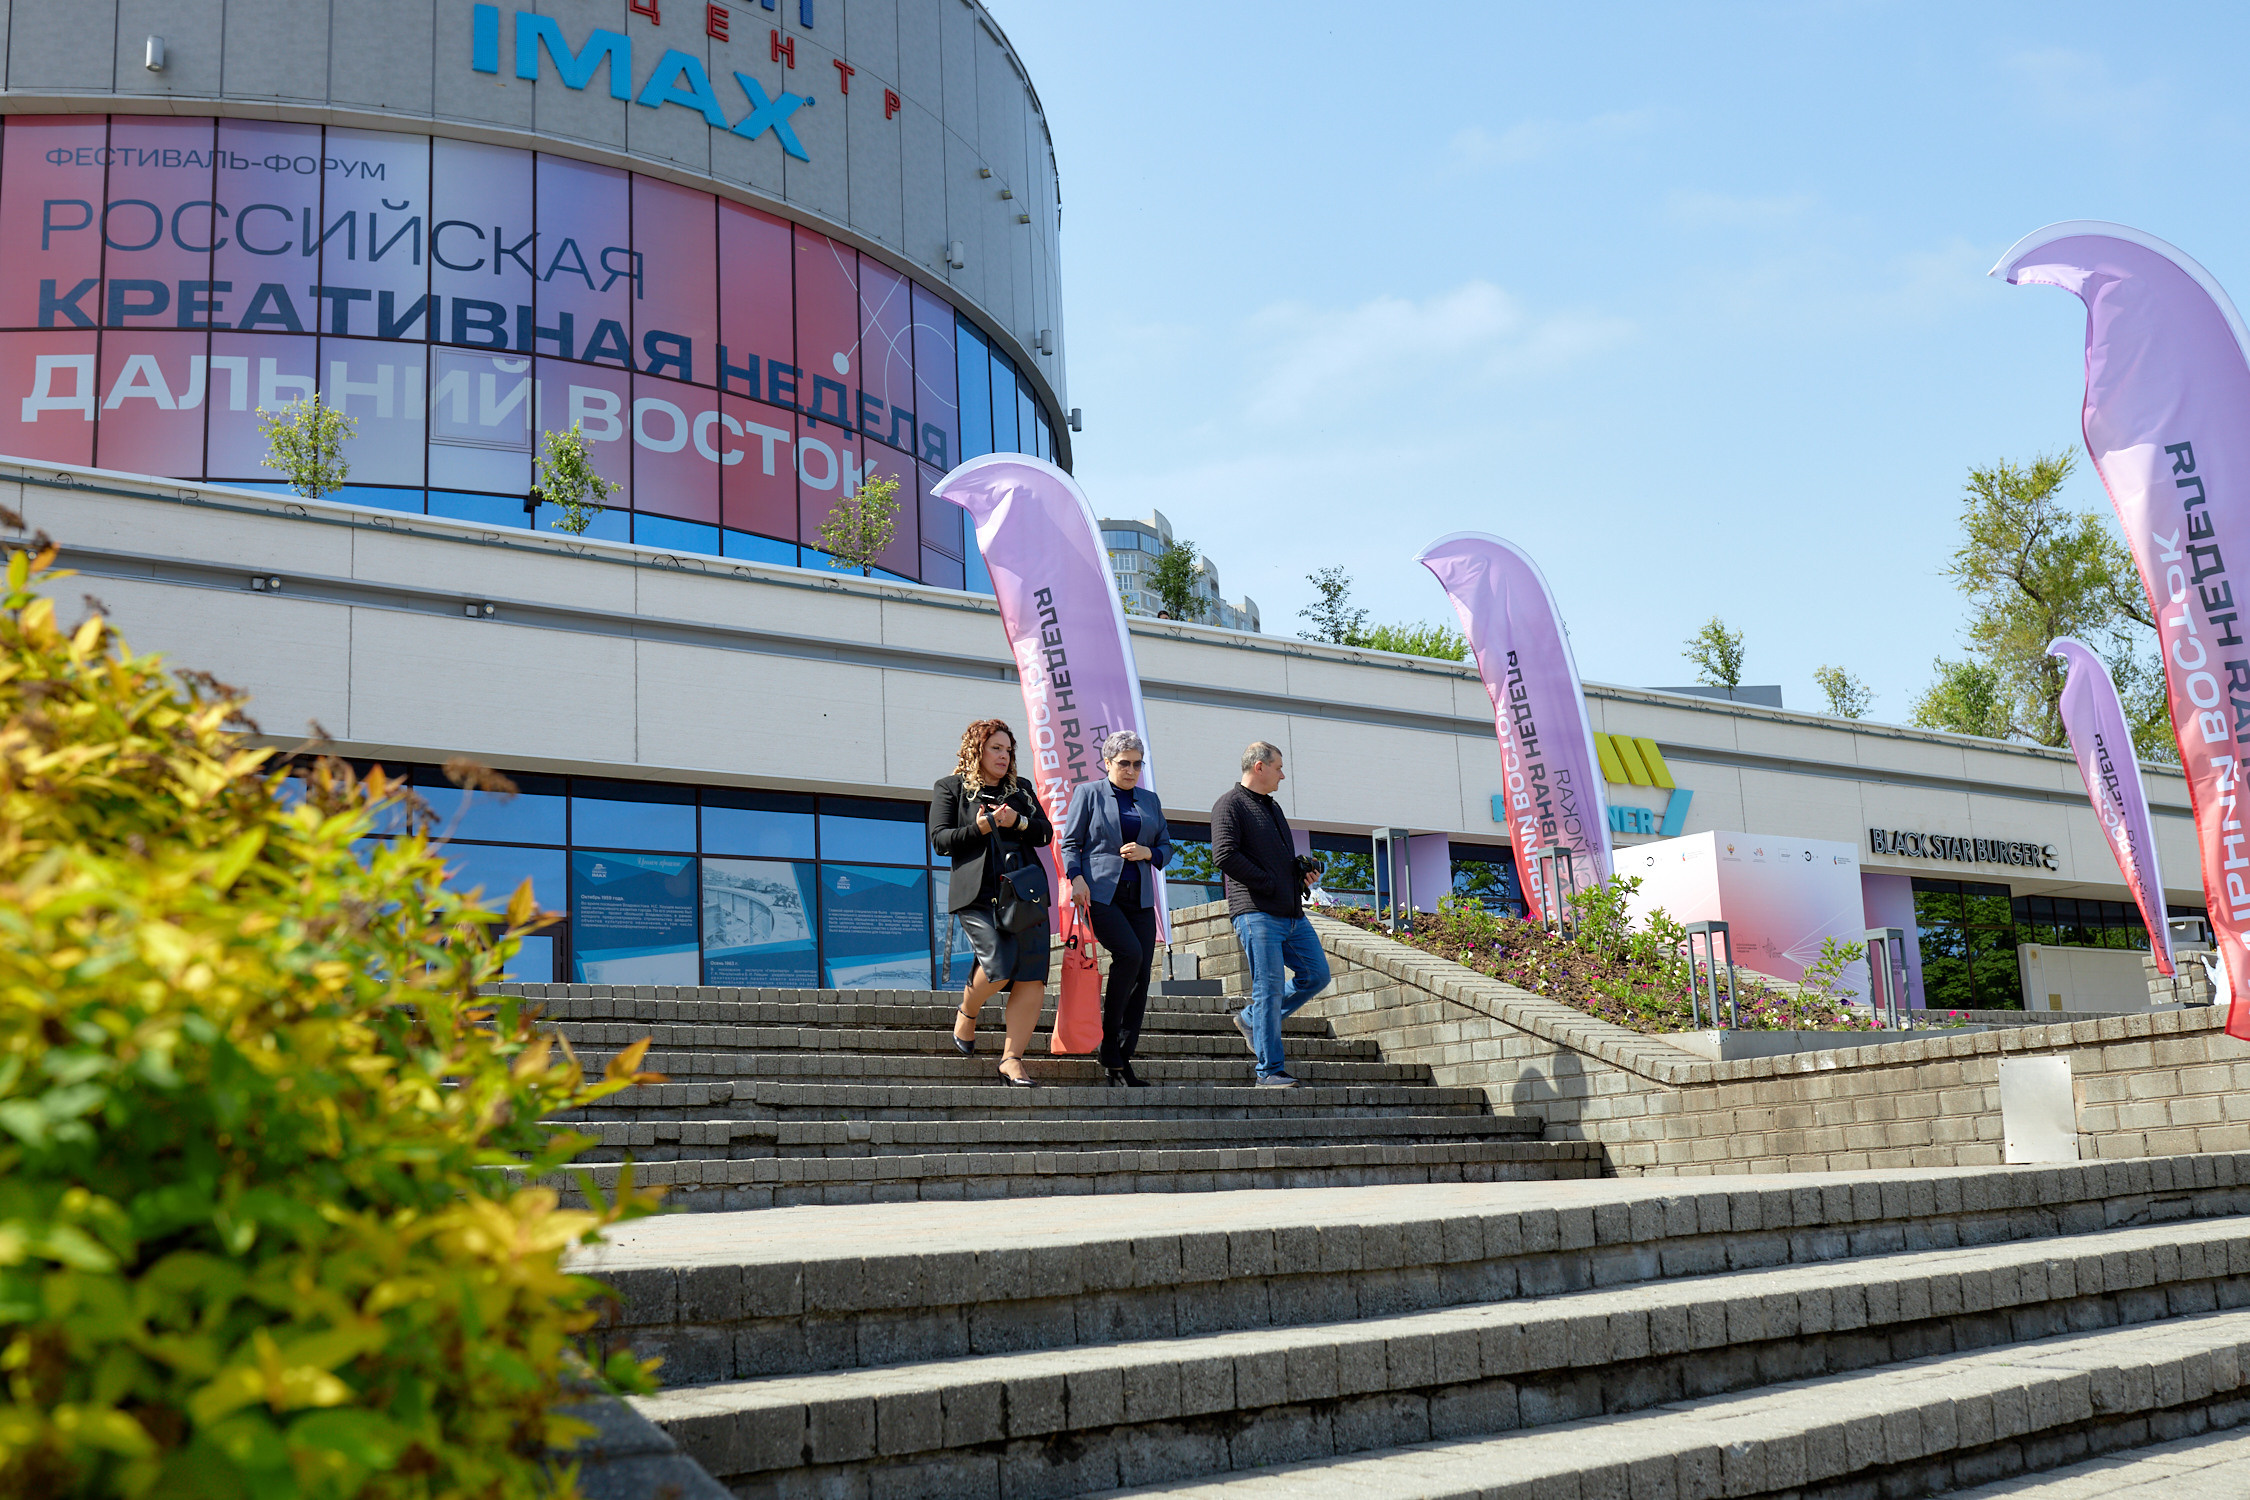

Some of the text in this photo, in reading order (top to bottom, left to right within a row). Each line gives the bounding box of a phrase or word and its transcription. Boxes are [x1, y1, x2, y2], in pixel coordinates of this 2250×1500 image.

[472, 4, 812, 162] IMAX
[45, 146, 386, 182] ФЕСТИВАЛЬ-ФОРУМ
[42, 198, 644, 300] РОССИЙСКАЯ
[22, 353, 878, 499] ДАЛЬНИЙ ВОСТОК
[38, 278, 948, 471] КРЕАТИВНАЯ НЕДЕЛЯ
[1870, 828, 2042, 867] BLACK STAR BURGER
